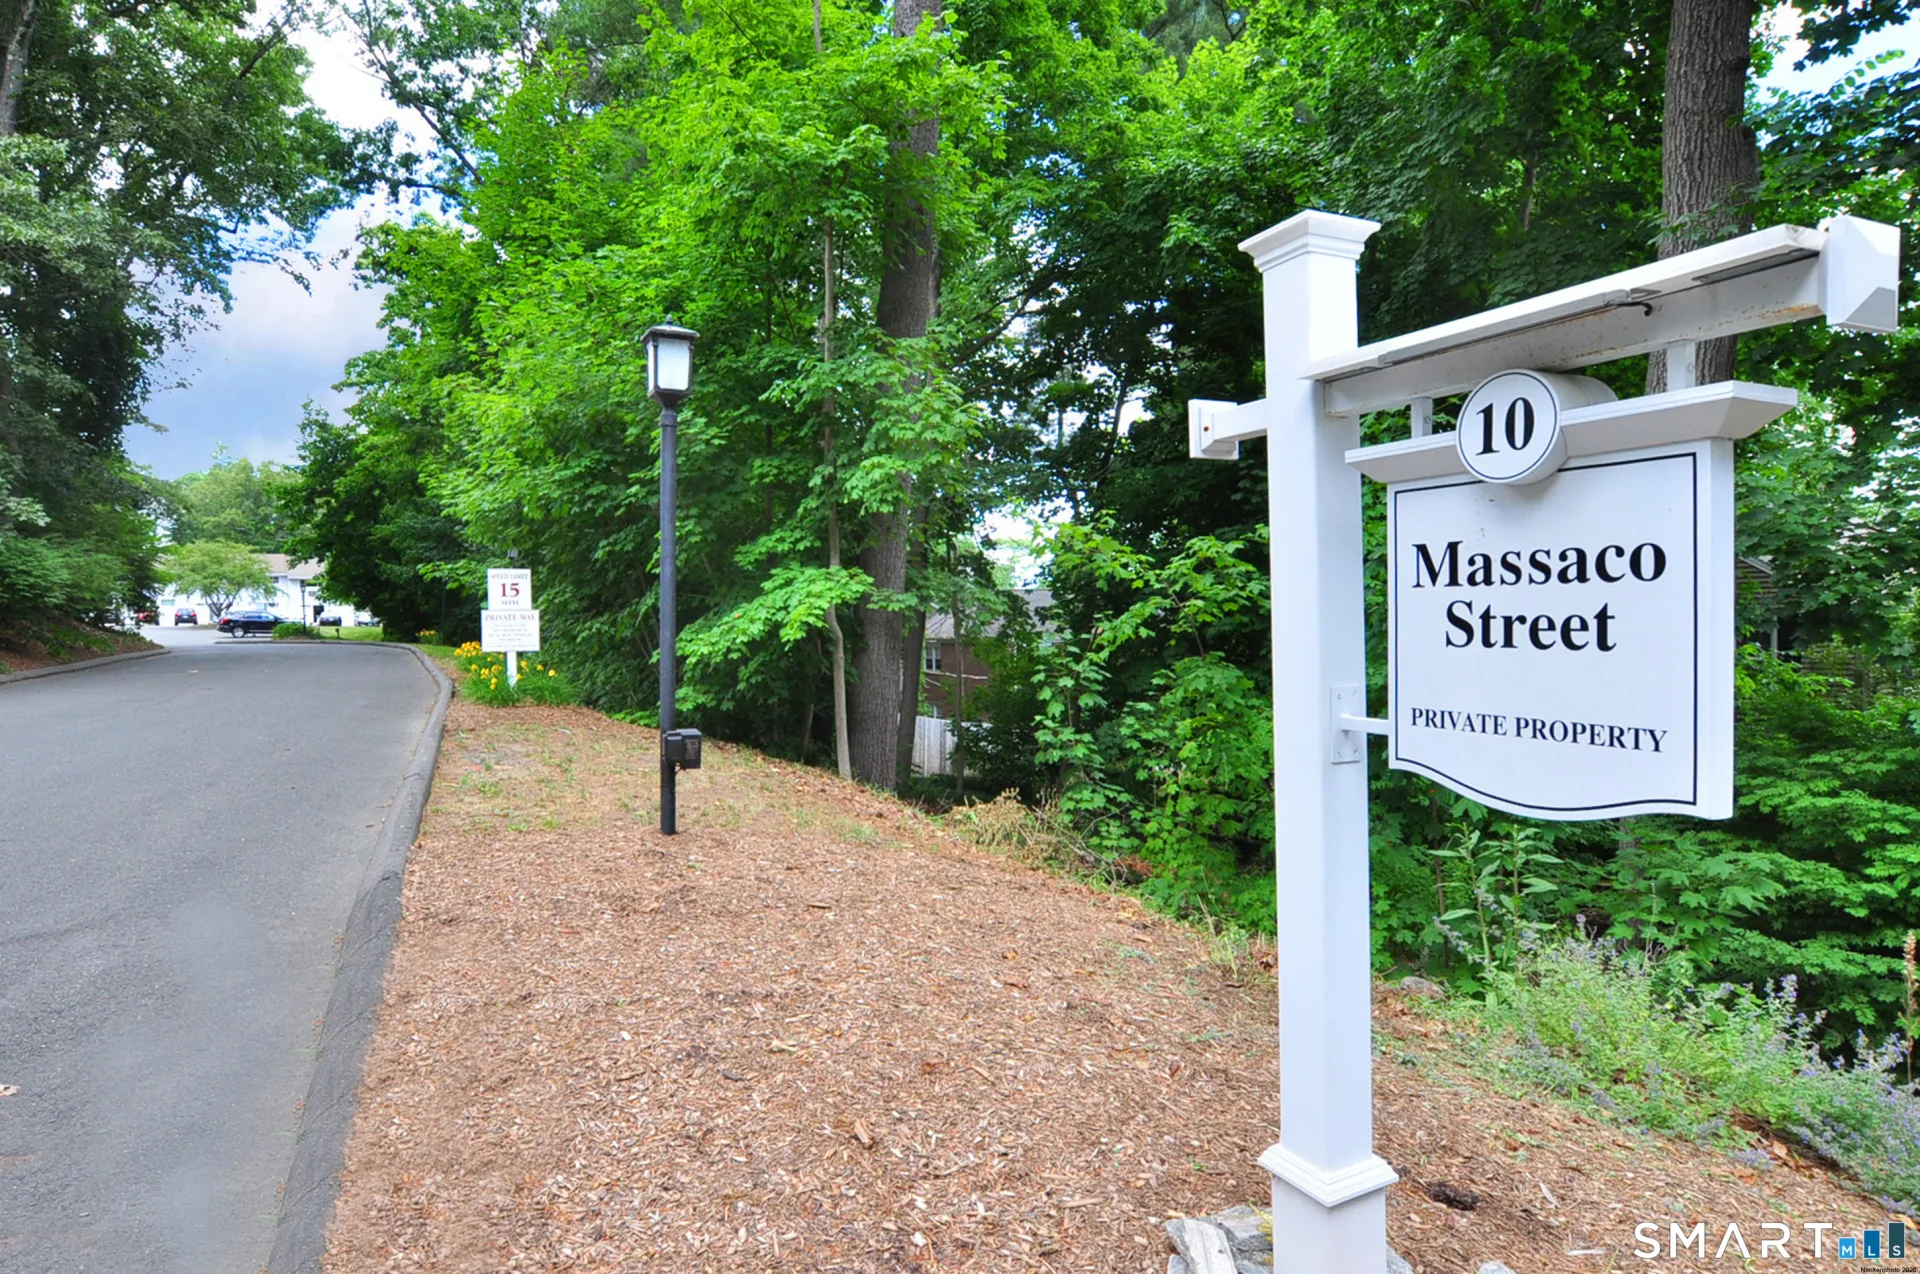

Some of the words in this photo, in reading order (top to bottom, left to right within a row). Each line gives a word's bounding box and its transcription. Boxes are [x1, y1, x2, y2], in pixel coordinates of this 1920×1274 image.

[1477, 396, 1535, 455] 10
[1412, 540, 1667, 589] Massaco
[500, 582, 520, 598] 15
[519, 613, 535, 621] WAY
[1446, 601, 1617, 653] Street
[1411, 707, 1508, 736] PRIVATE
[1515, 716, 1668, 753] PROPERTY
